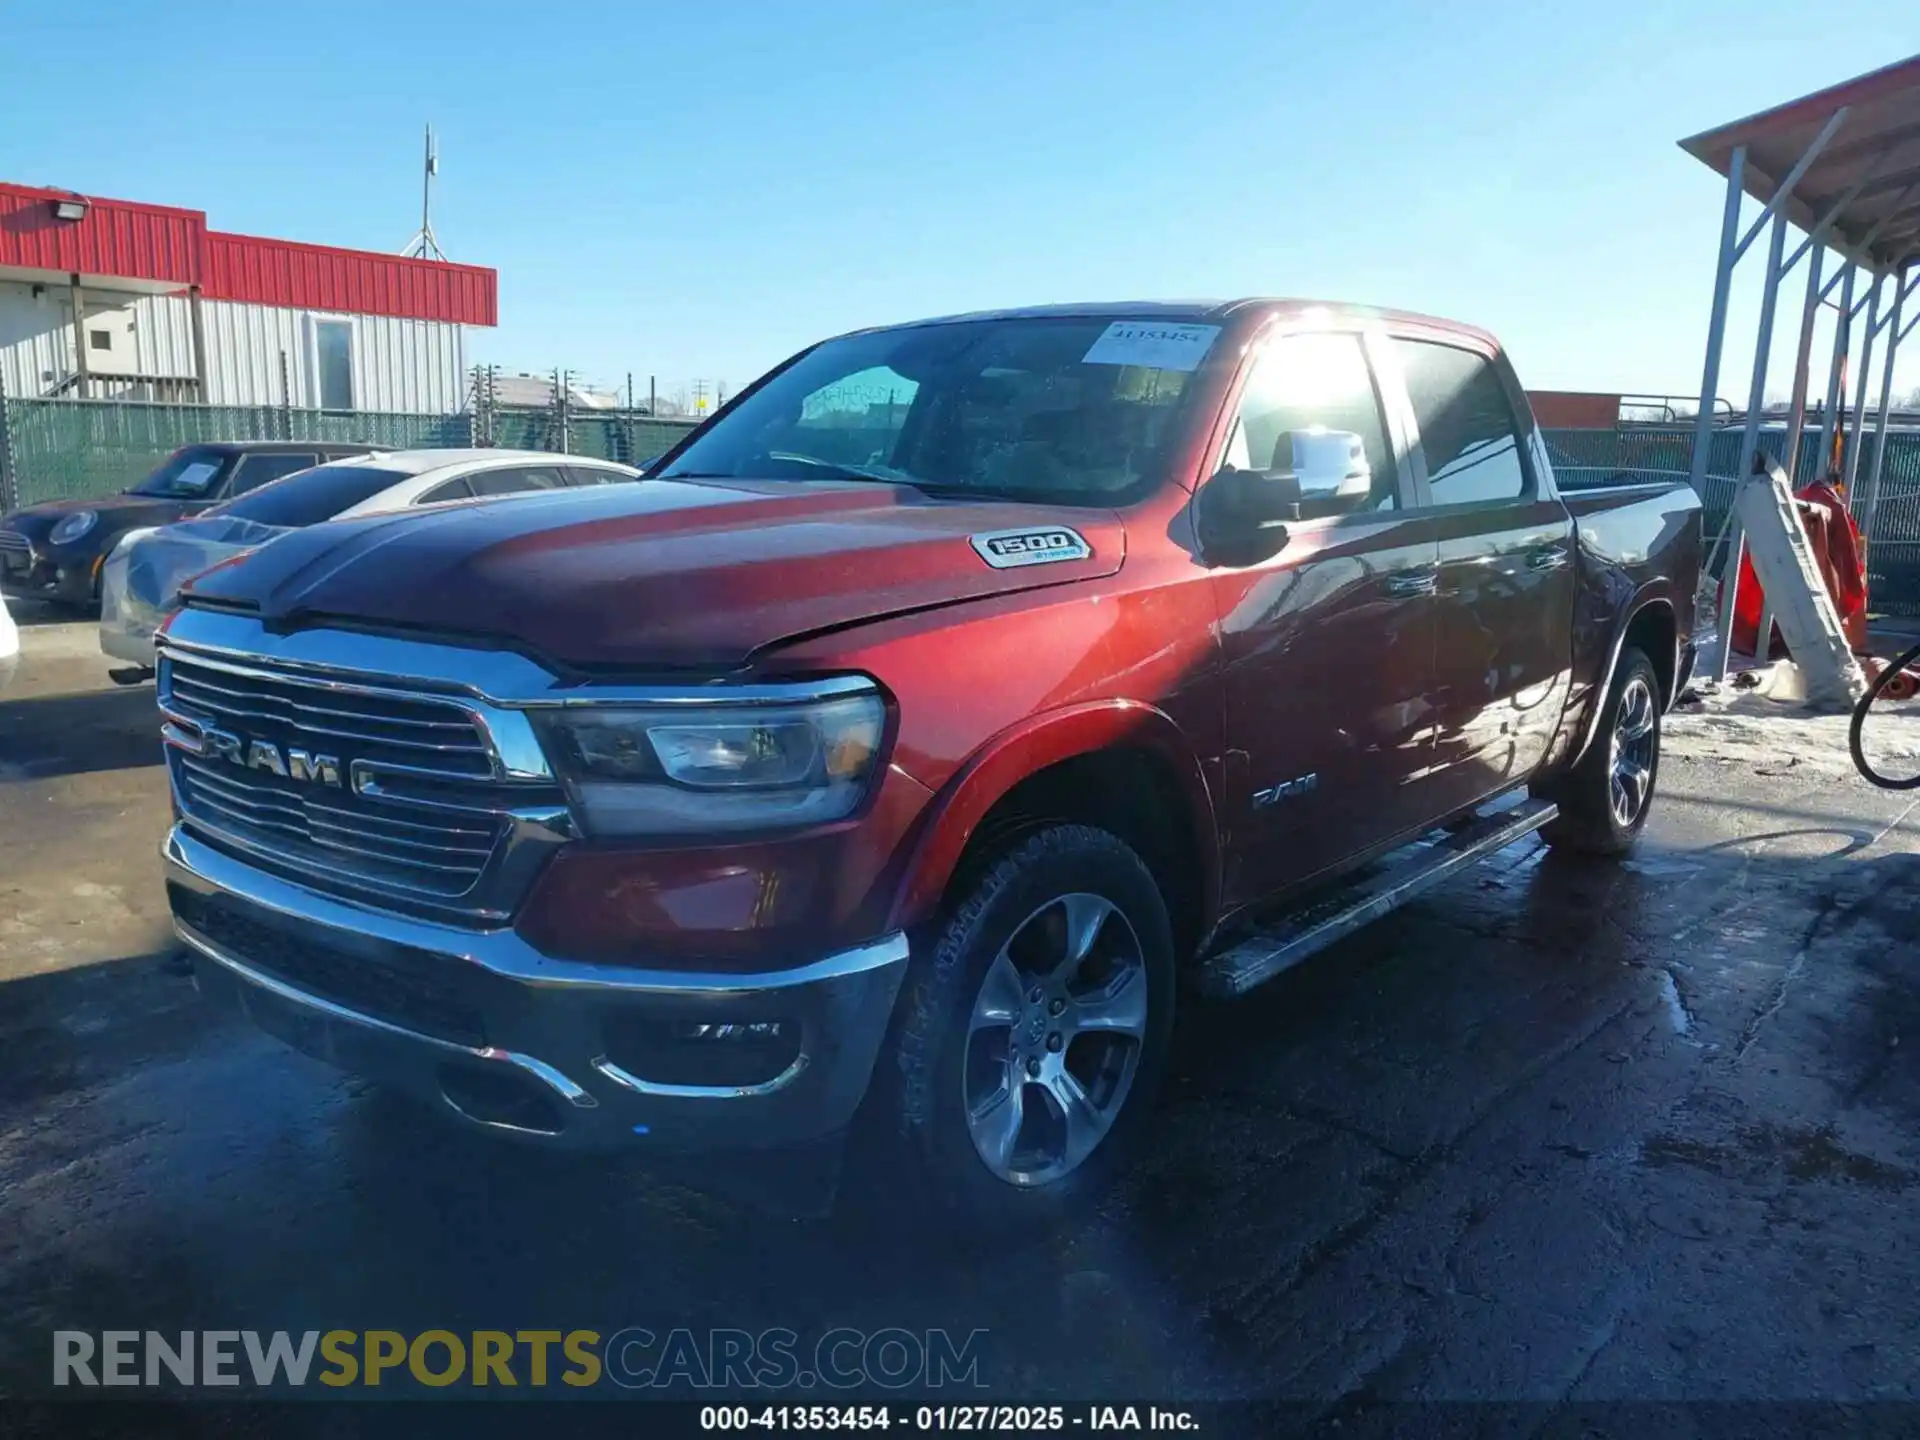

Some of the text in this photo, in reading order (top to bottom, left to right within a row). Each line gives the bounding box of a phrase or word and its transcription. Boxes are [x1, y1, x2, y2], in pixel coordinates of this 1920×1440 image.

[992, 534, 1069, 553] 1500
[202, 727, 342, 788] RAM
[1252, 772, 1317, 810] RAM
